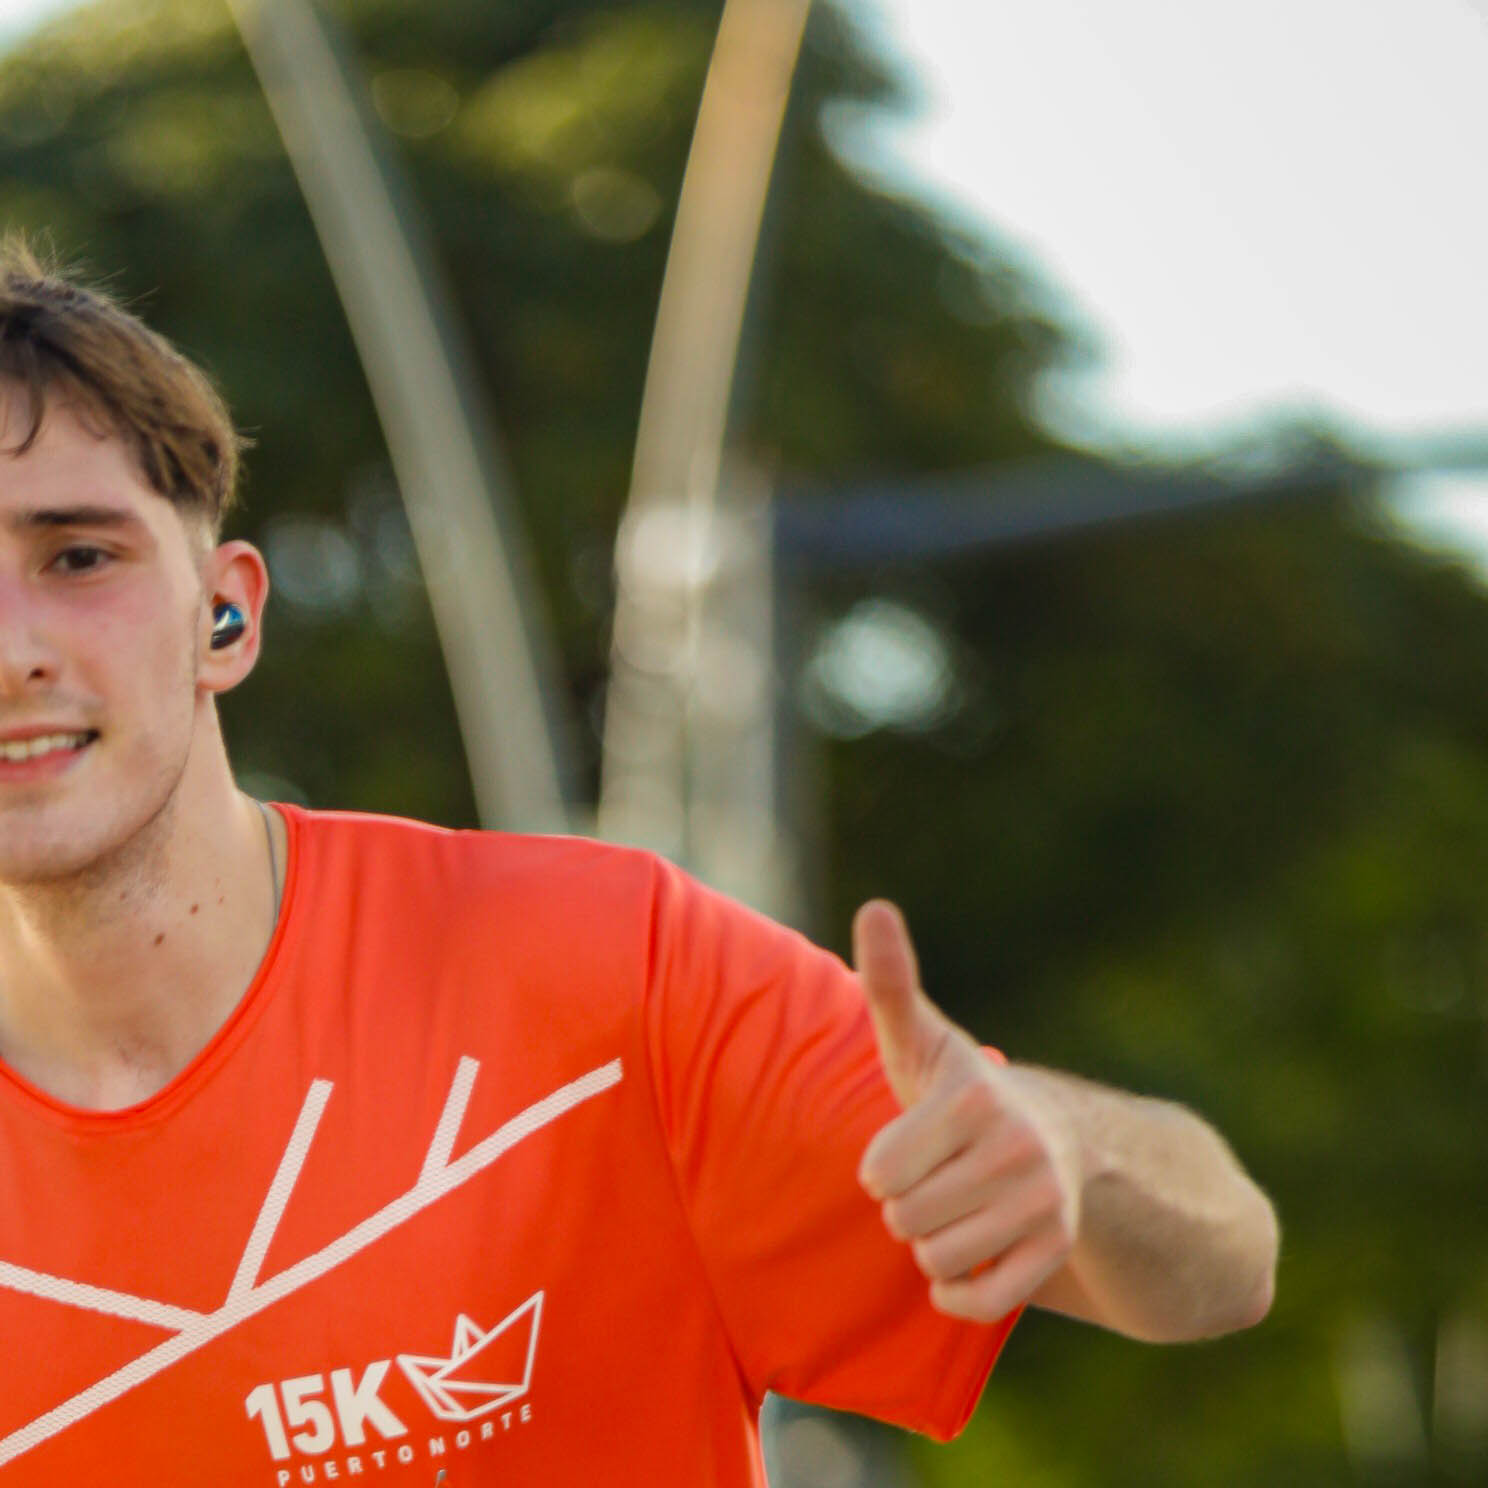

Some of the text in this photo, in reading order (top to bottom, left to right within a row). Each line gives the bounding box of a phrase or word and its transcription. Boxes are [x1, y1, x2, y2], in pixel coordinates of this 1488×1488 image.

[245, 1359, 408, 1461] 15K
[277, 1403, 532, 1488] PUERTO NORTE
